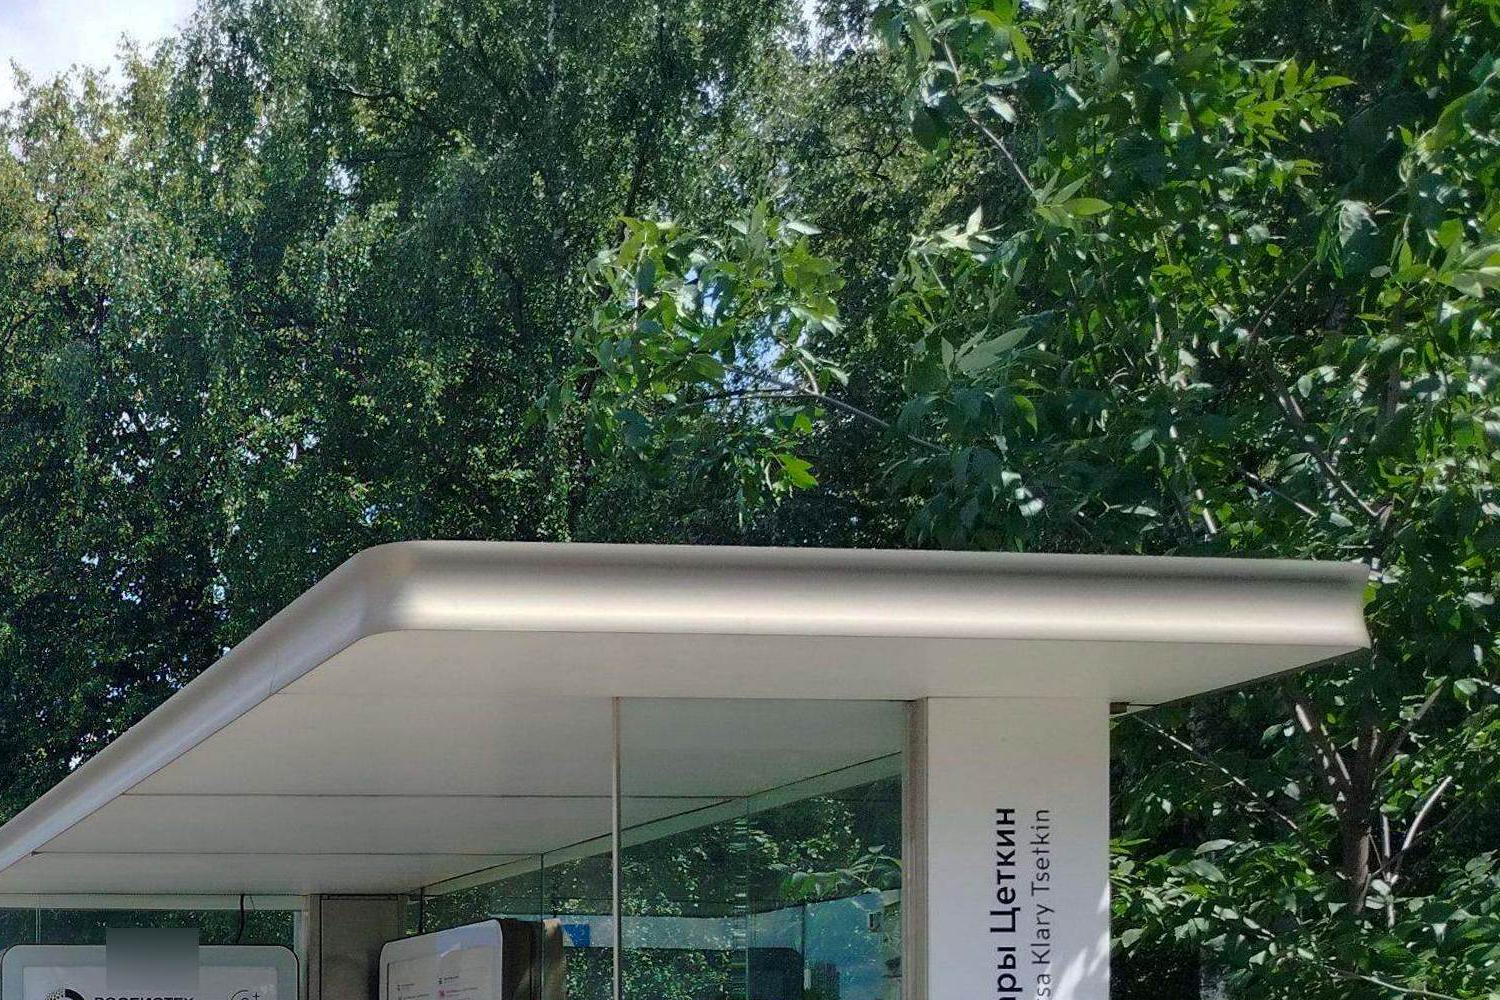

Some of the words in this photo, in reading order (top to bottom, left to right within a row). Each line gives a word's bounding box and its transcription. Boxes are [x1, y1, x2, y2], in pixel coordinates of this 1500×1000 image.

[990, 808, 1021, 932] Цеткин
[1029, 810, 1050, 896] Tsetkin
[1031, 904, 1054, 964] Klary
